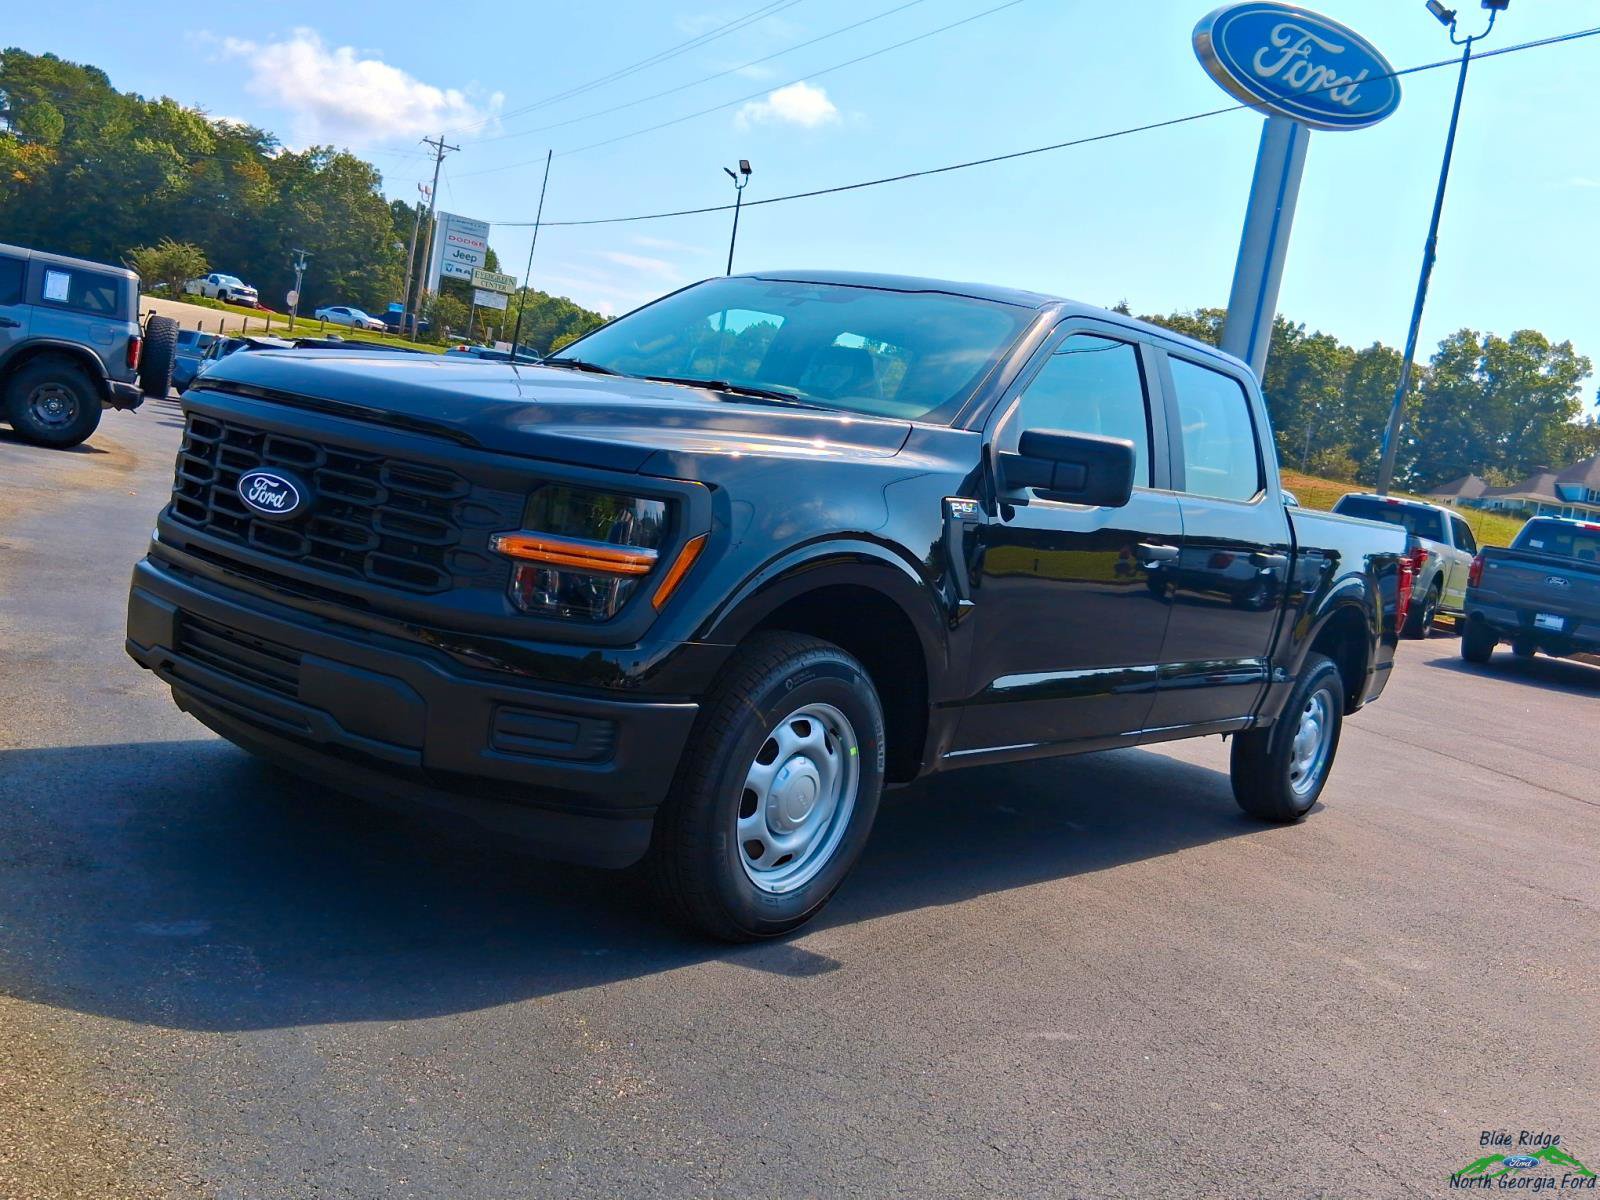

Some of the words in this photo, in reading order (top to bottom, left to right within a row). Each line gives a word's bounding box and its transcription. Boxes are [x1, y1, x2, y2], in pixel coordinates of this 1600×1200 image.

[1253, 22, 1369, 107] Ford
[448, 235, 486, 249] DODGE
[453, 250, 477, 264] Jeep
[456, 267, 470, 276] RA
[475, 271, 514, 286] EVERGREEN
[480, 280, 507, 291] CENTER
[249, 477, 288, 508] Ford
